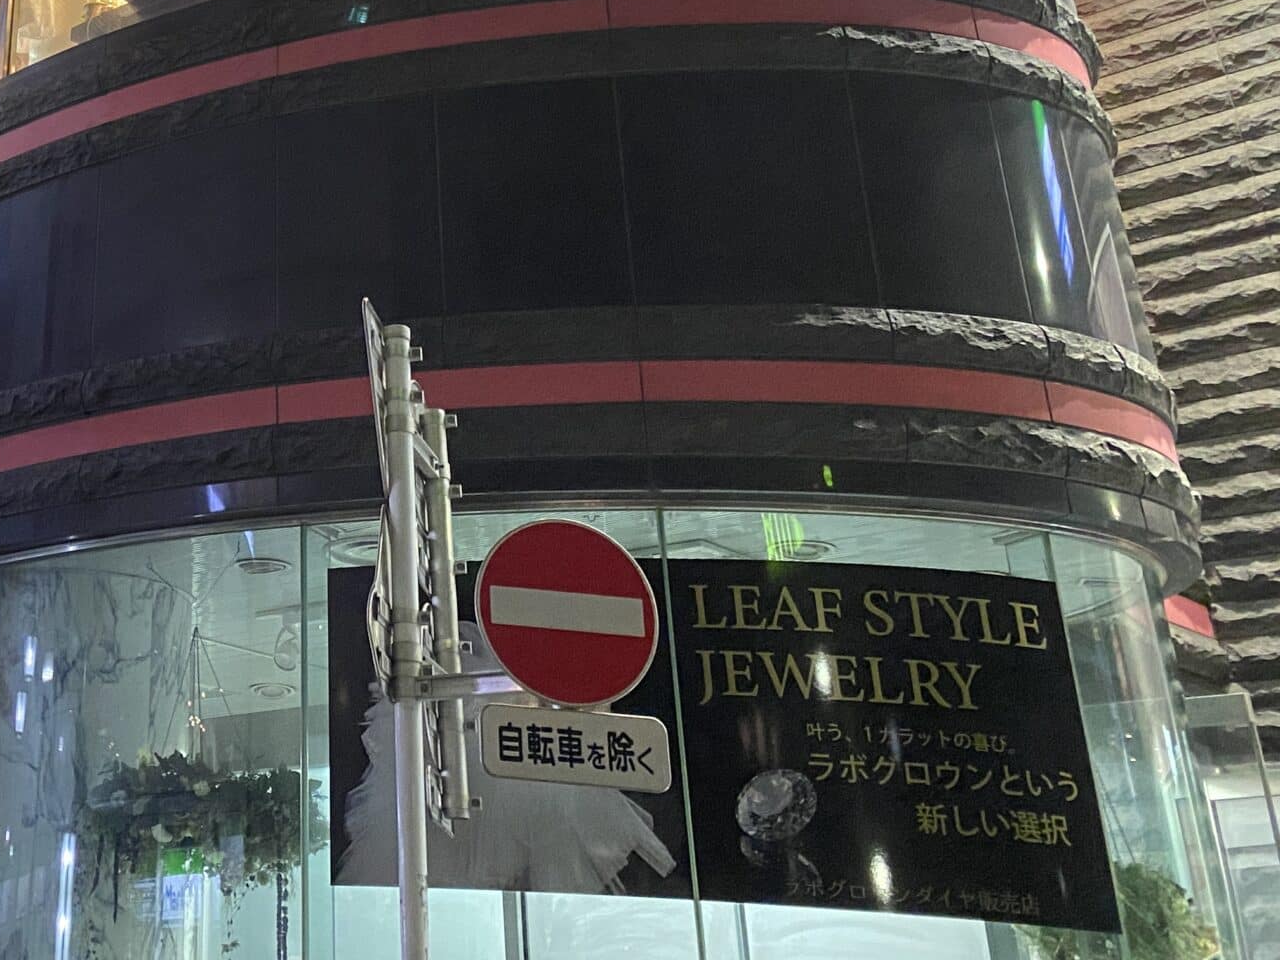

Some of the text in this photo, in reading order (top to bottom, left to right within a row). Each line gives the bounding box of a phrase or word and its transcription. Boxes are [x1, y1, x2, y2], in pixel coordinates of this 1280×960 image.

[688, 584, 1048, 650] LEAF STYLE
[696, 649, 982, 709] JEWELRY
[498, 722, 654, 777] 自転車を除く
[807, 752, 1080, 802] ラボグロウンという
[915, 802, 1073, 846] 新しい選択
[784, 879, 1041, 916] ラボグロンダイヤ販売店
